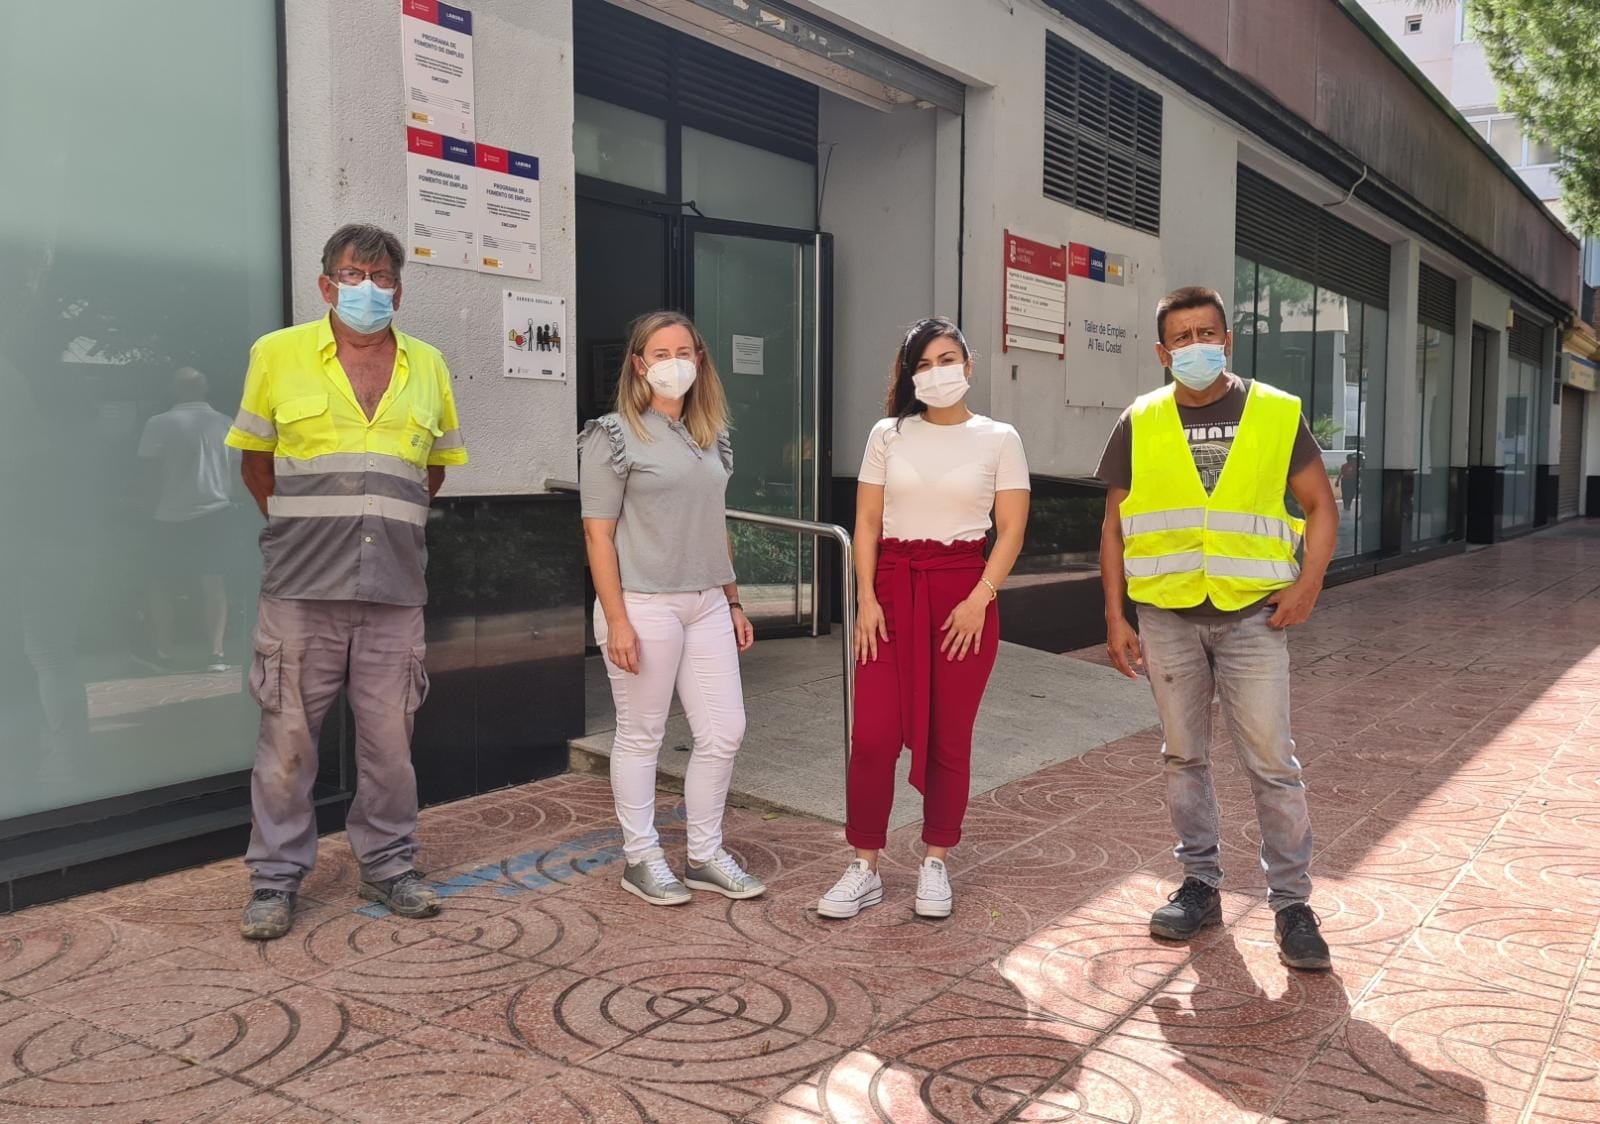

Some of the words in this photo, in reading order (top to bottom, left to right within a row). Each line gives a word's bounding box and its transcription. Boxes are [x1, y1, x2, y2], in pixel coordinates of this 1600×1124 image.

[414, 38, 438, 51] FOMENTO
[438, 46, 445, 54] DE
[445, 48, 465, 60] EMPLEO
[422, 32, 449, 47] PROGRAMA
[450, 41, 457, 49] DE
[418, 174, 442, 185] FOMENTO
[449, 181, 469, 191] EMPLEO
[426, 168, 453, 180] PROGRAMA
[486, 188, 508, 199] FOMENTO
[514, 194, 532, 203] EMPLEO
[493, 182, 518, 193] PROGRAMA
[1084, 319, 1098, 333] Taller
[1098, 323, 1106, 335] de
[1106, 323, 1126, 340] Empleo
[1087, 337, 1094, 350] Al
[1095, 338, 1105, 352] Teu
[1105, 340, 1122, 354] Costat
